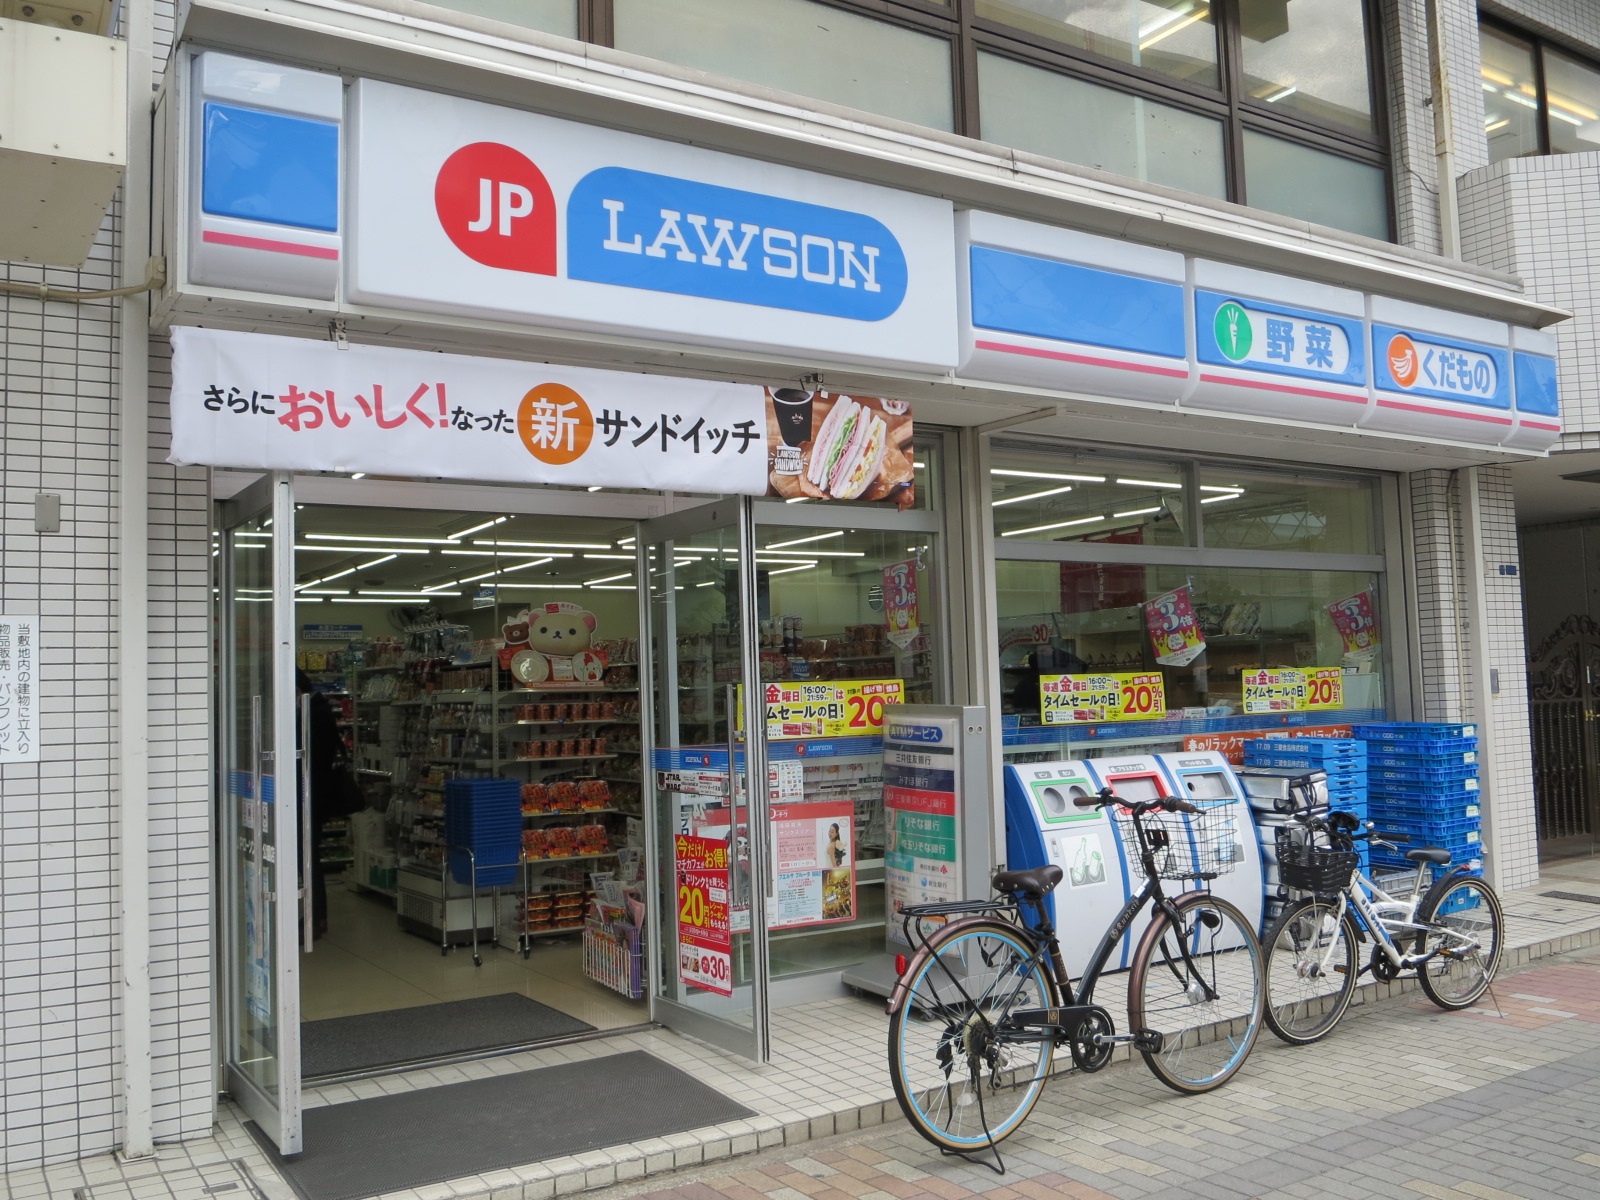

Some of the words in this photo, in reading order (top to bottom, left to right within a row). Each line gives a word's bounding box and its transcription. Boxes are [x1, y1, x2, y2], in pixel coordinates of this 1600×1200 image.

[468, 178, 533, 236] JP
[603, 199, 881, 293] LAWSON
[1266, 318, 1333, 369] 野菜
[1422, 348, 1491, 394] くだもの
[777, 449, 800, 459] LAWSON
[774, 458, 803, 471] SANDWICH
[17, 623, 31, 755] 当敷地内の建物に立入り
[1044, 692, 1120, 709] タイムセールの日!
[891, 725, 939, 740] ATMサービス
[808, 744, 833, 752] LAWSON
[896, 753, 931, 766] 三井住友銀行
